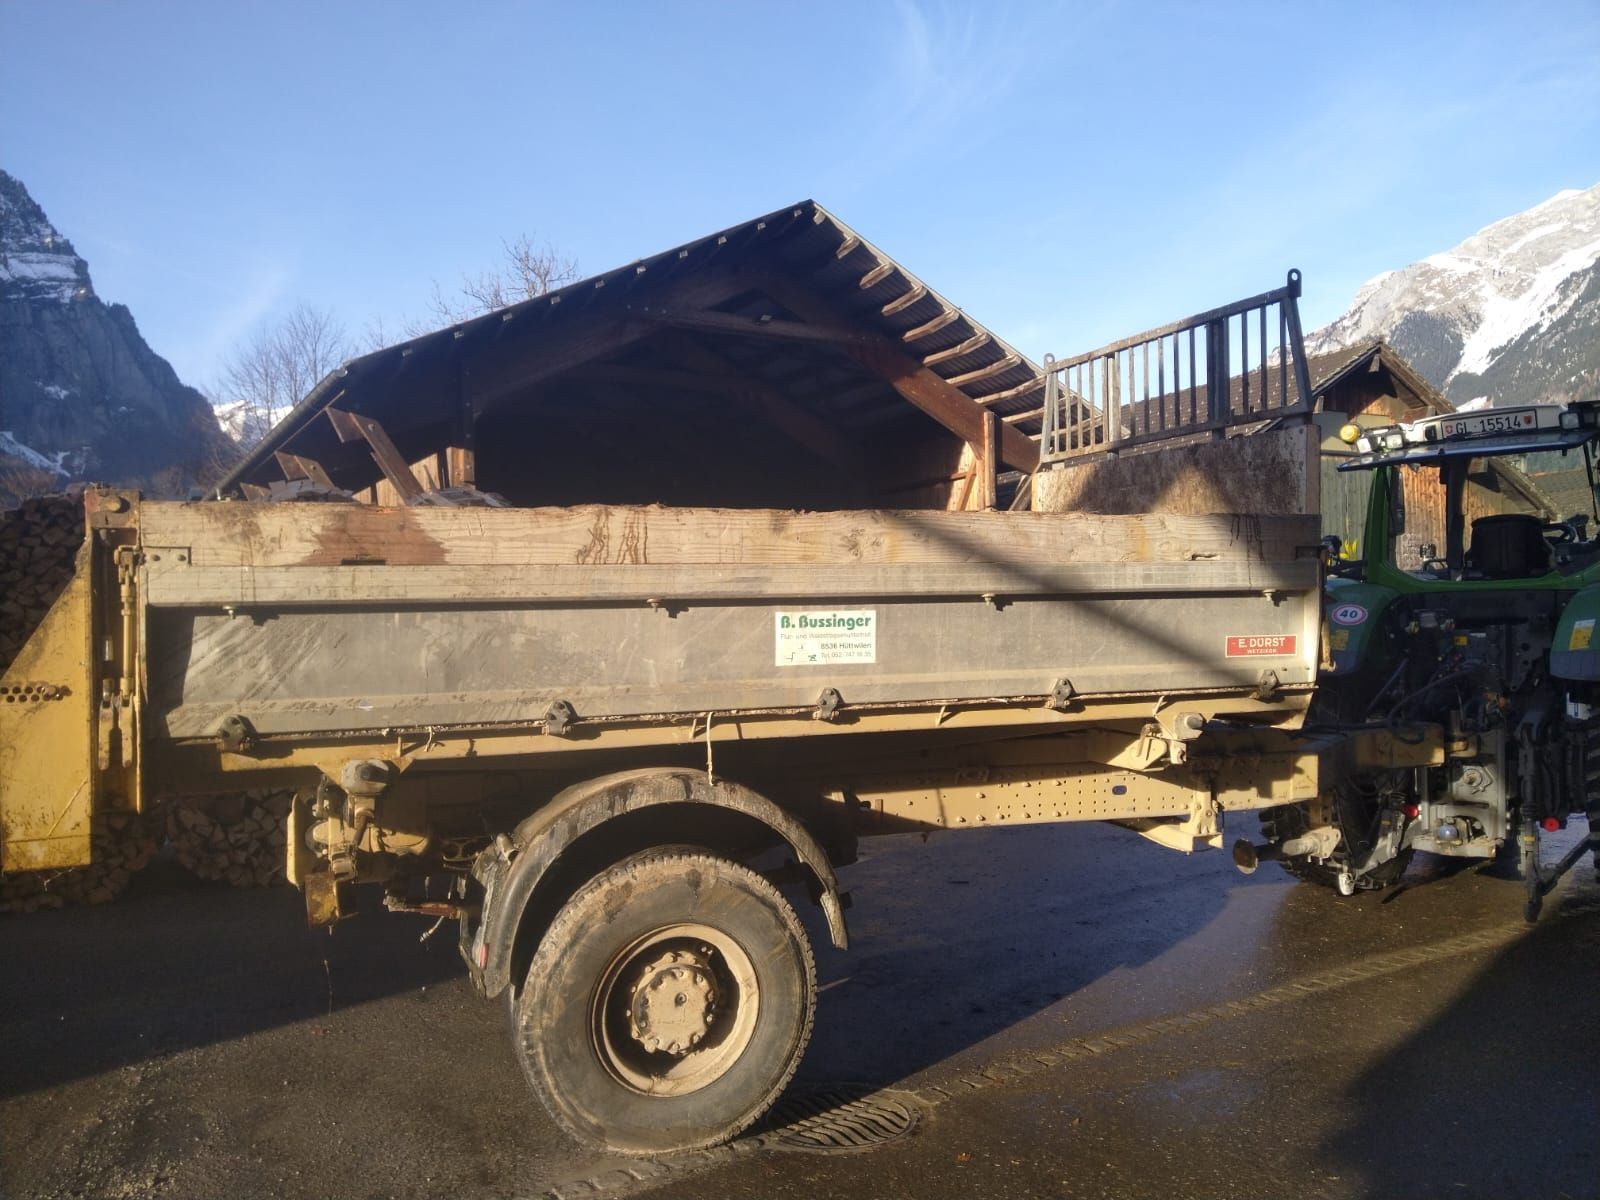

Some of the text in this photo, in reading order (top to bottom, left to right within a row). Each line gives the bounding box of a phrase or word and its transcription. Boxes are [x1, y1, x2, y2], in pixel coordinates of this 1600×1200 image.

[1455, 415, 1522, 435] GL 15514
[781, 613, 872, 631] B. Bussinger
[1339, 610, 1358, 619] 40
